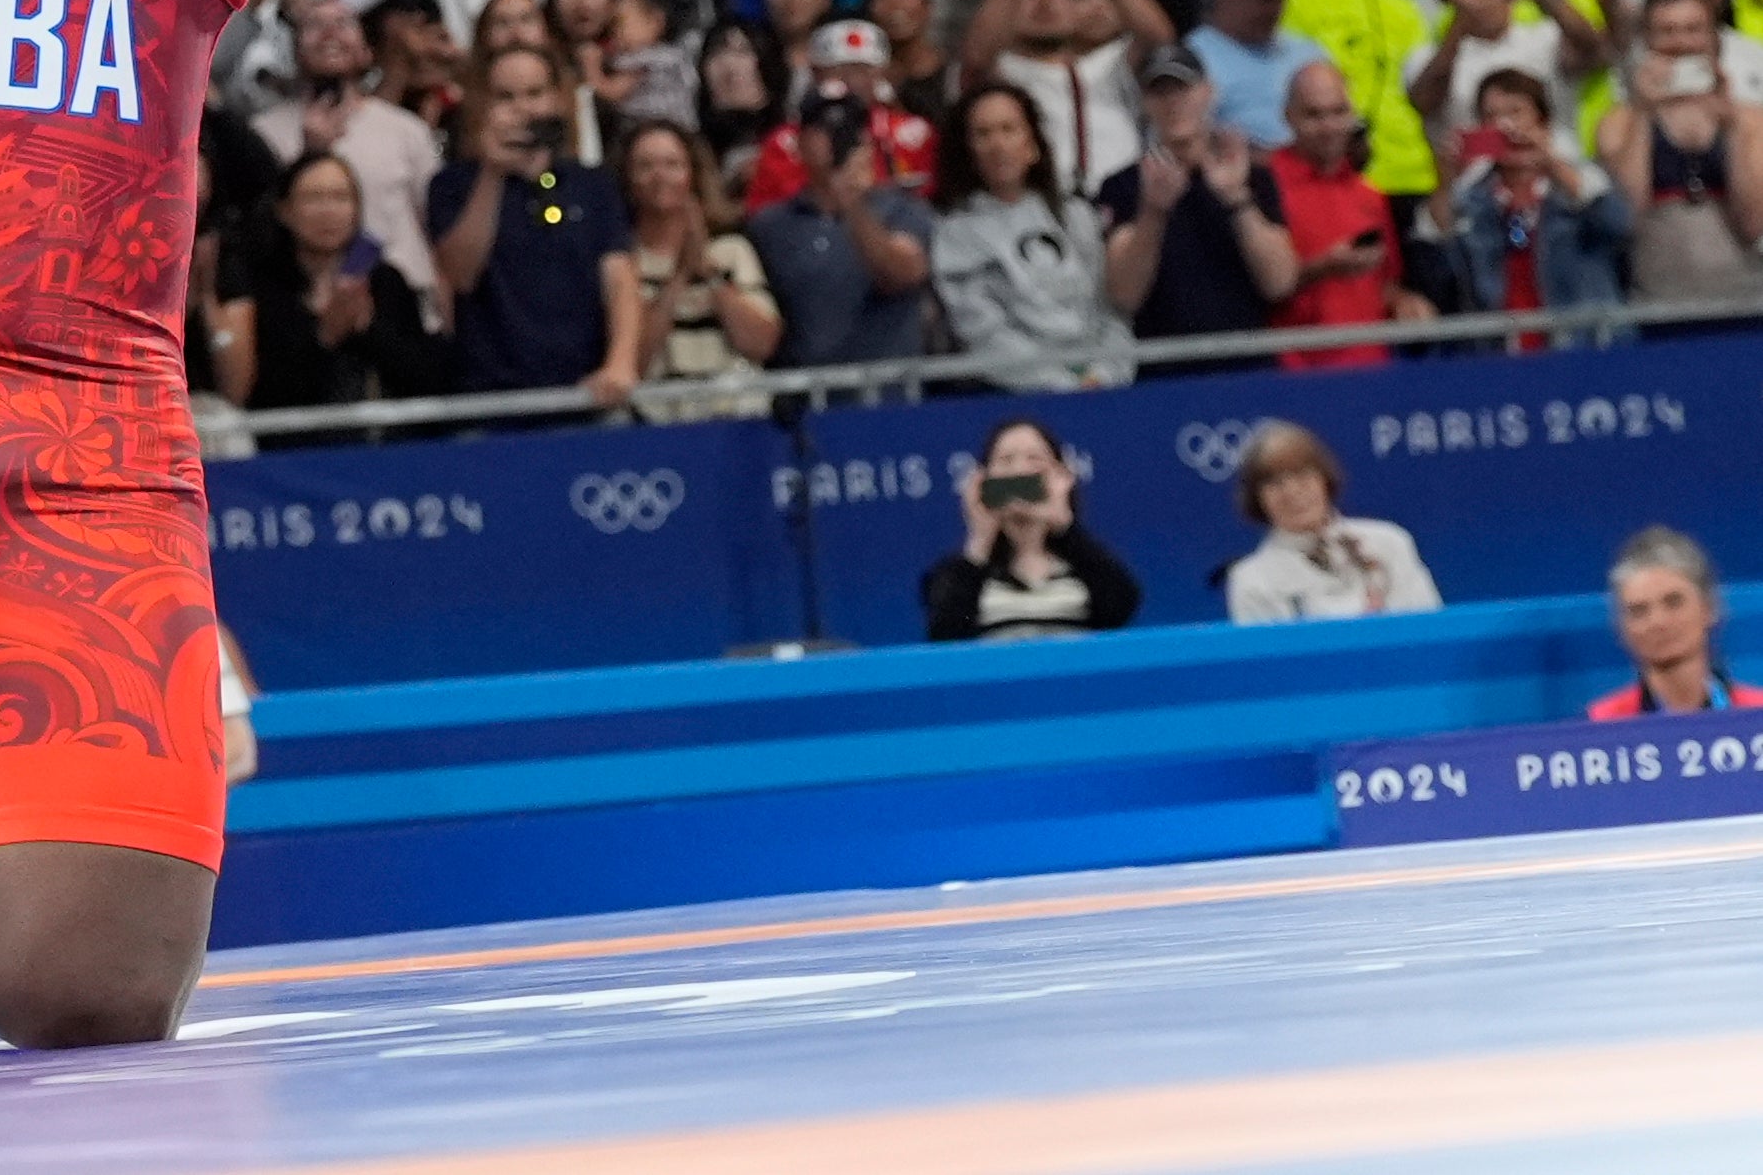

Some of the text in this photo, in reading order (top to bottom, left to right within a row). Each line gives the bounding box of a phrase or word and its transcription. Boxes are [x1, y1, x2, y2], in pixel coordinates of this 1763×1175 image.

[1371, 392, 1685, 459] PARIS 2024
[770, 454, 933, 509] PARIS
[207, 493, 484, 552] RIS 2024
[1336, 761, 1468, 809] 2024
[1515, 742, 1663, 792] PARIS
